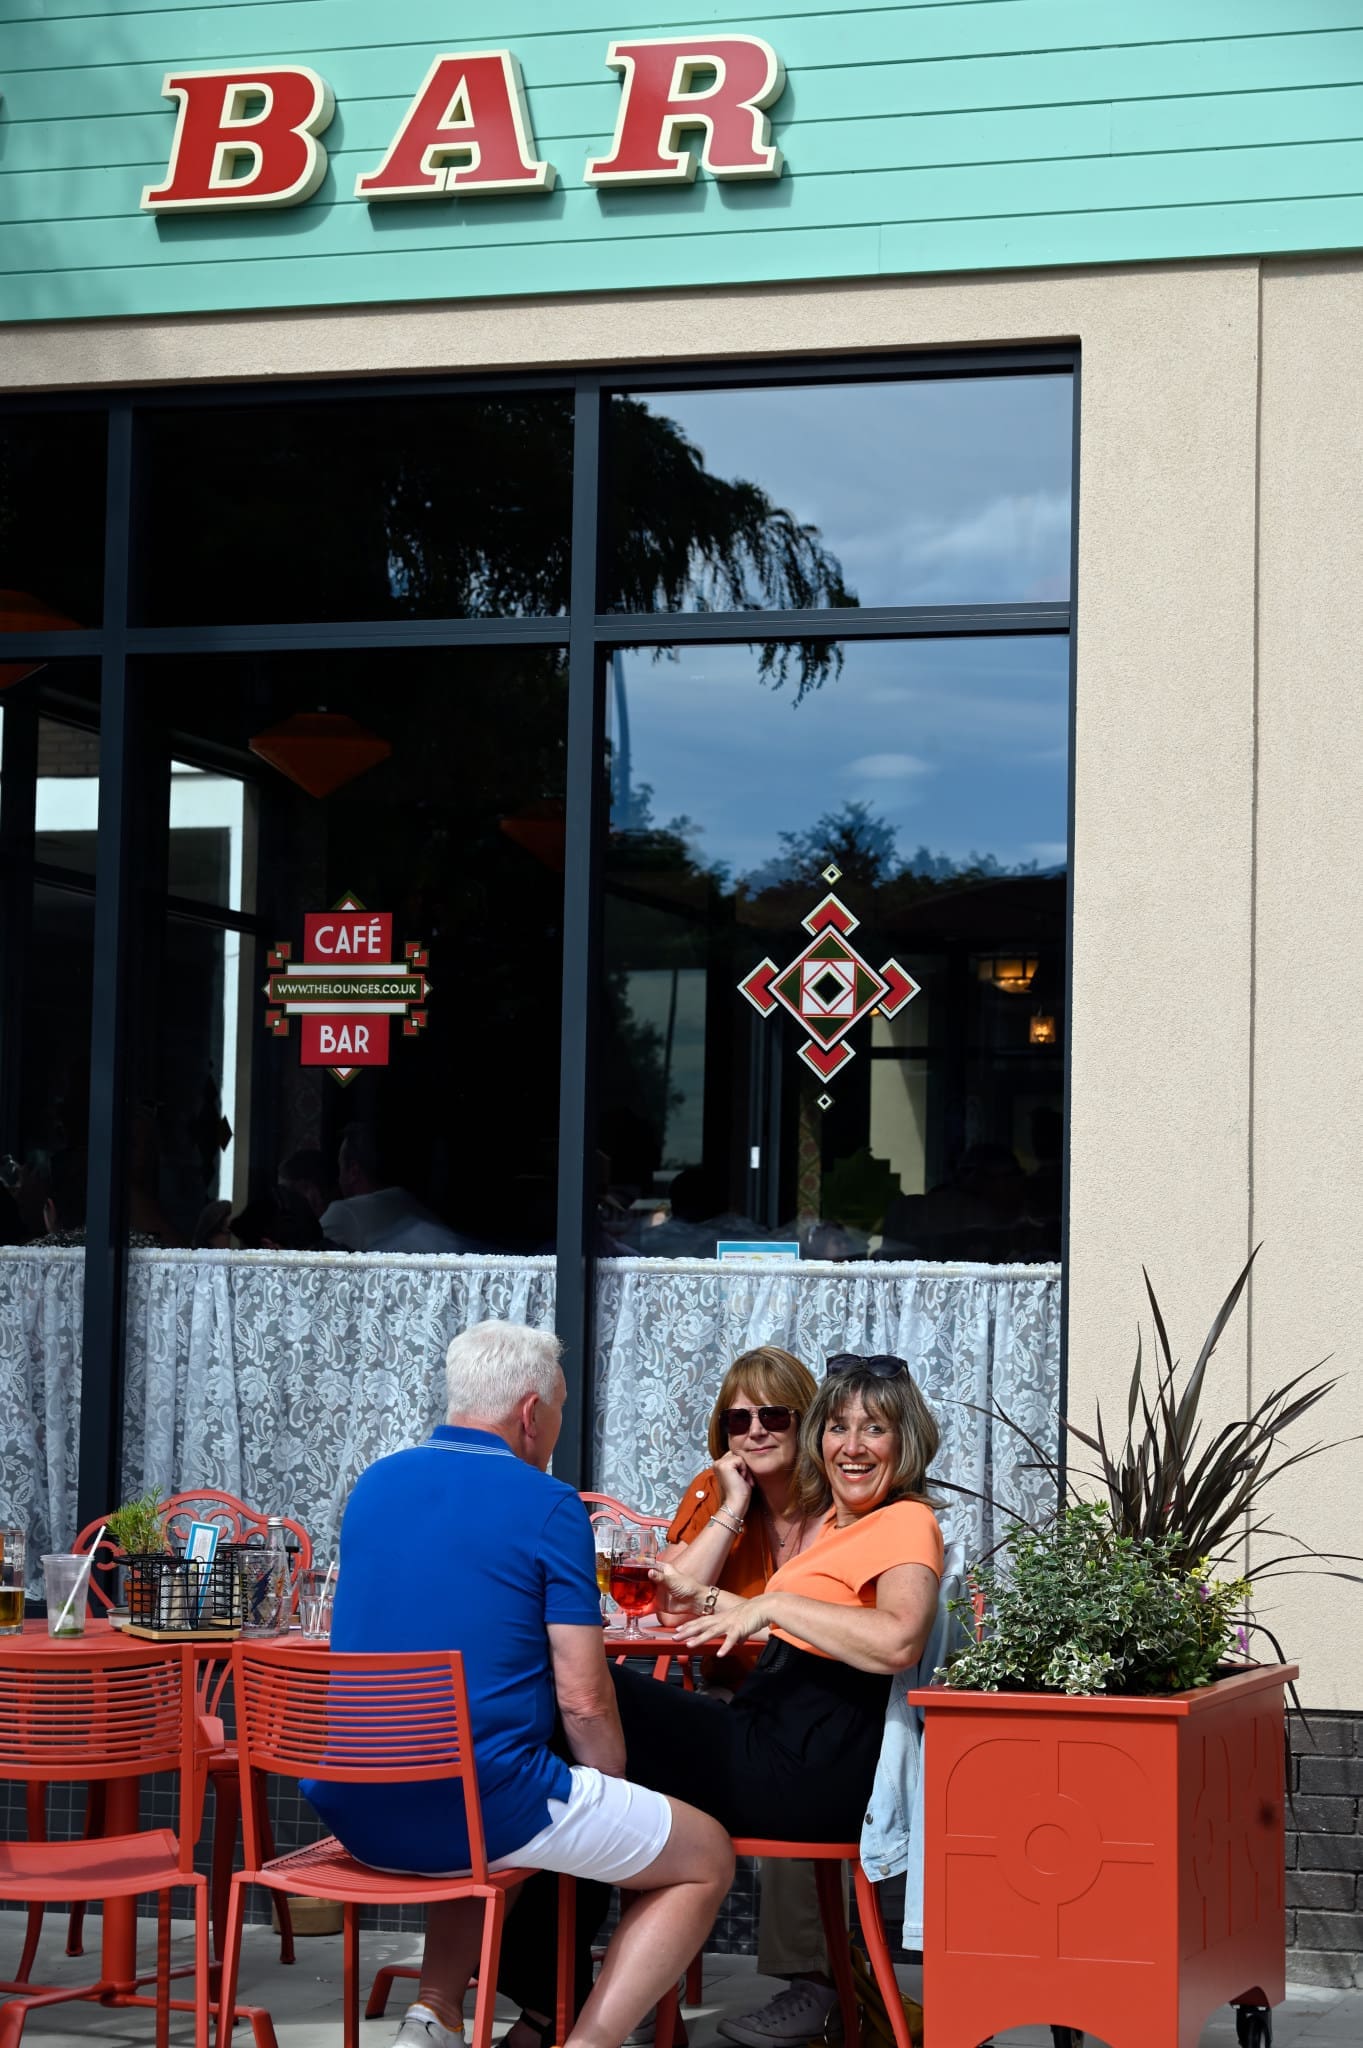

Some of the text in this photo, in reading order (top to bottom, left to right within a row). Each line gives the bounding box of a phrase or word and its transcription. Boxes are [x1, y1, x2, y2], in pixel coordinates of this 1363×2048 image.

[140, 33, 786, 216] BAR
[314, 917, 382, 954] CAFÉ
[277, 983, 417, 995] WWW.THELOUNGES.CO.UK
[319, 1024, 369, 1054] BAR
